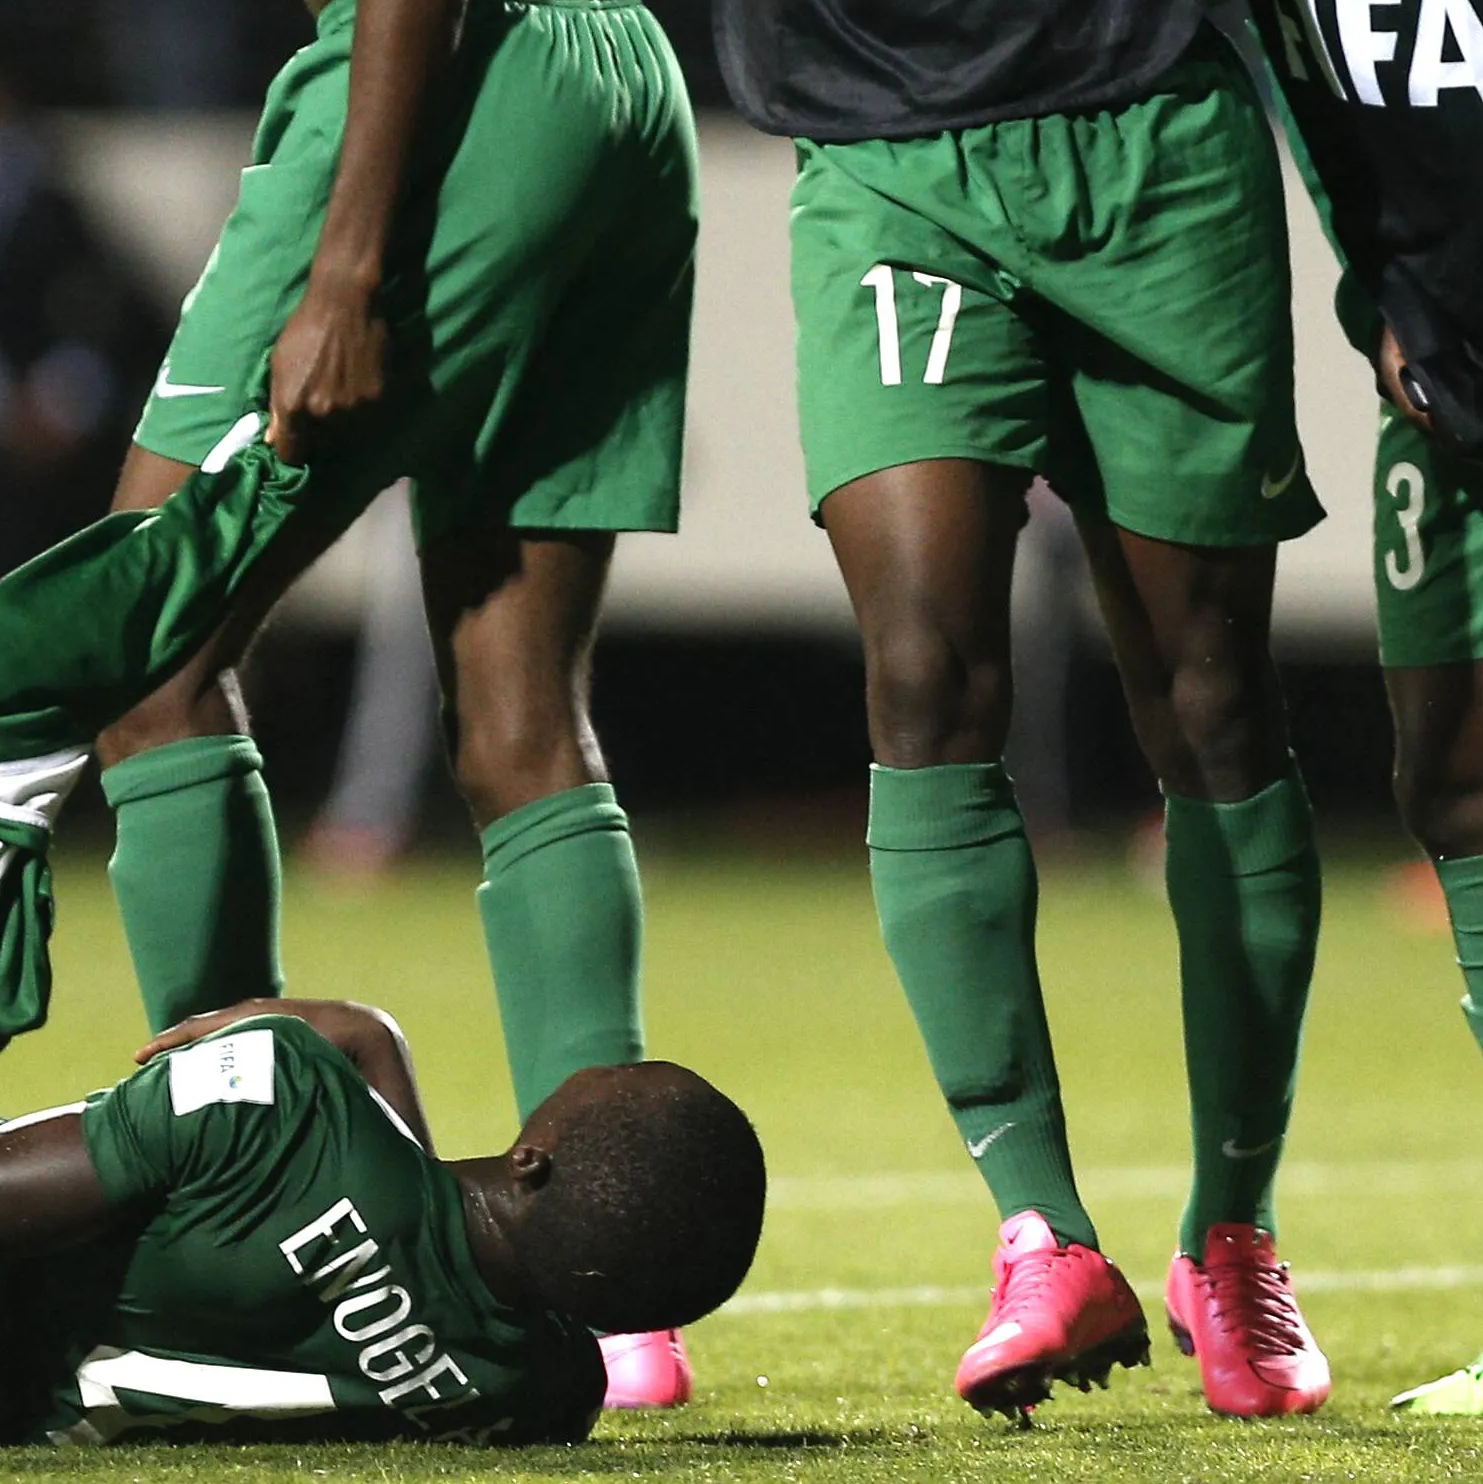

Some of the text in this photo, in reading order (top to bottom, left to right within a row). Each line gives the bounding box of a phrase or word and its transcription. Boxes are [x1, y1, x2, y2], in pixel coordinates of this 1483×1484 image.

[860, 262, 962, 386] 17
[1383, 461, 1426, 591] 3
[218, 1042, 236, 1074] FIFA
